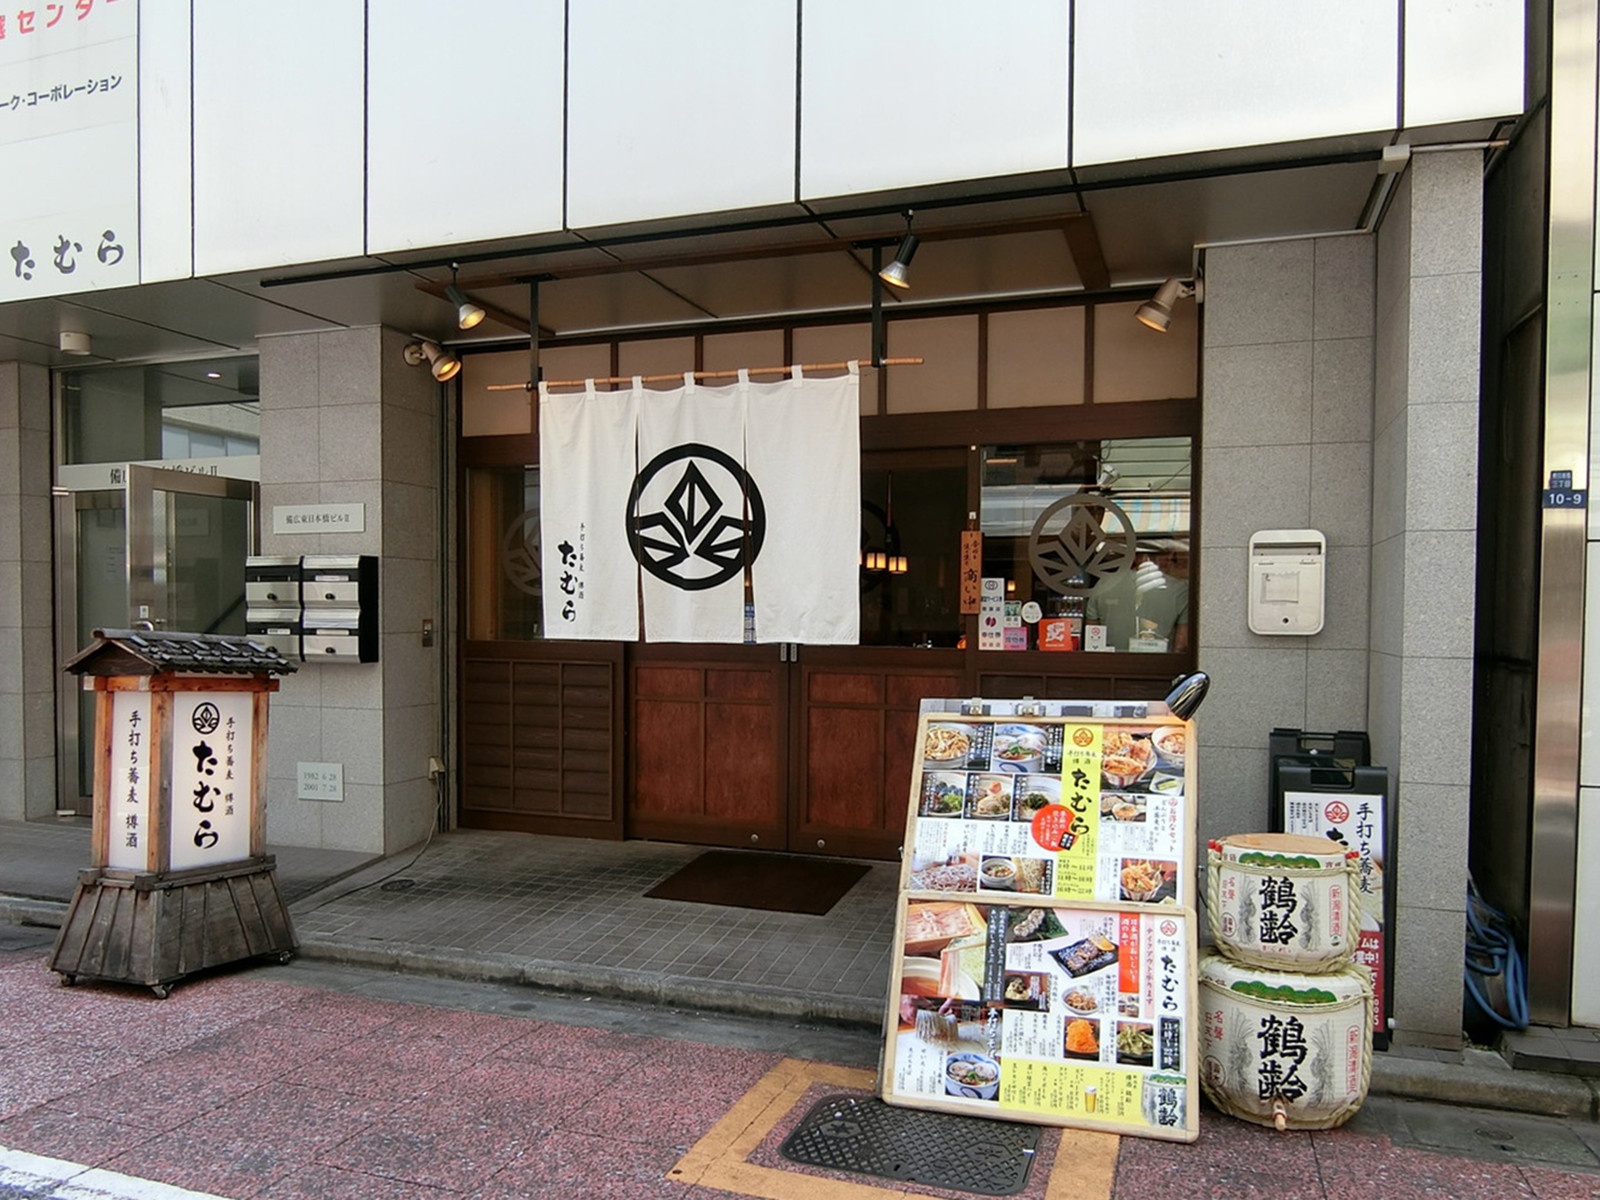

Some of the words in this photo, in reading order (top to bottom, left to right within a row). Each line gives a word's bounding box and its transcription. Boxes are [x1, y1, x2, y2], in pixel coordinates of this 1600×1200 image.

[0, 0, 127, 40] センタ
[10, 229, 124, 281] たむら
[1549, 493, 1582, 504] 10-9
[557, 540, 578, 623] たむら
[126, 710, 142, 804] 手打ち蕎麦
[225, 717, 236, 781] 手打ち蕎麦
[192, 740, 221, 850] たむら
[1070, 768, 1093, 836] たむら
[125, 813, 139, 849] 樽酒
[1356, 802, 1374, 894] 手打ち蕎麦
[1258, 875, 1299, 945] 鶴齢
[1331, 889, 1342, 933] 新潟清酒
[1161, 954, 1179, 1011] たむら
[1257, 1013, 1308, 1103] 鶴齢
